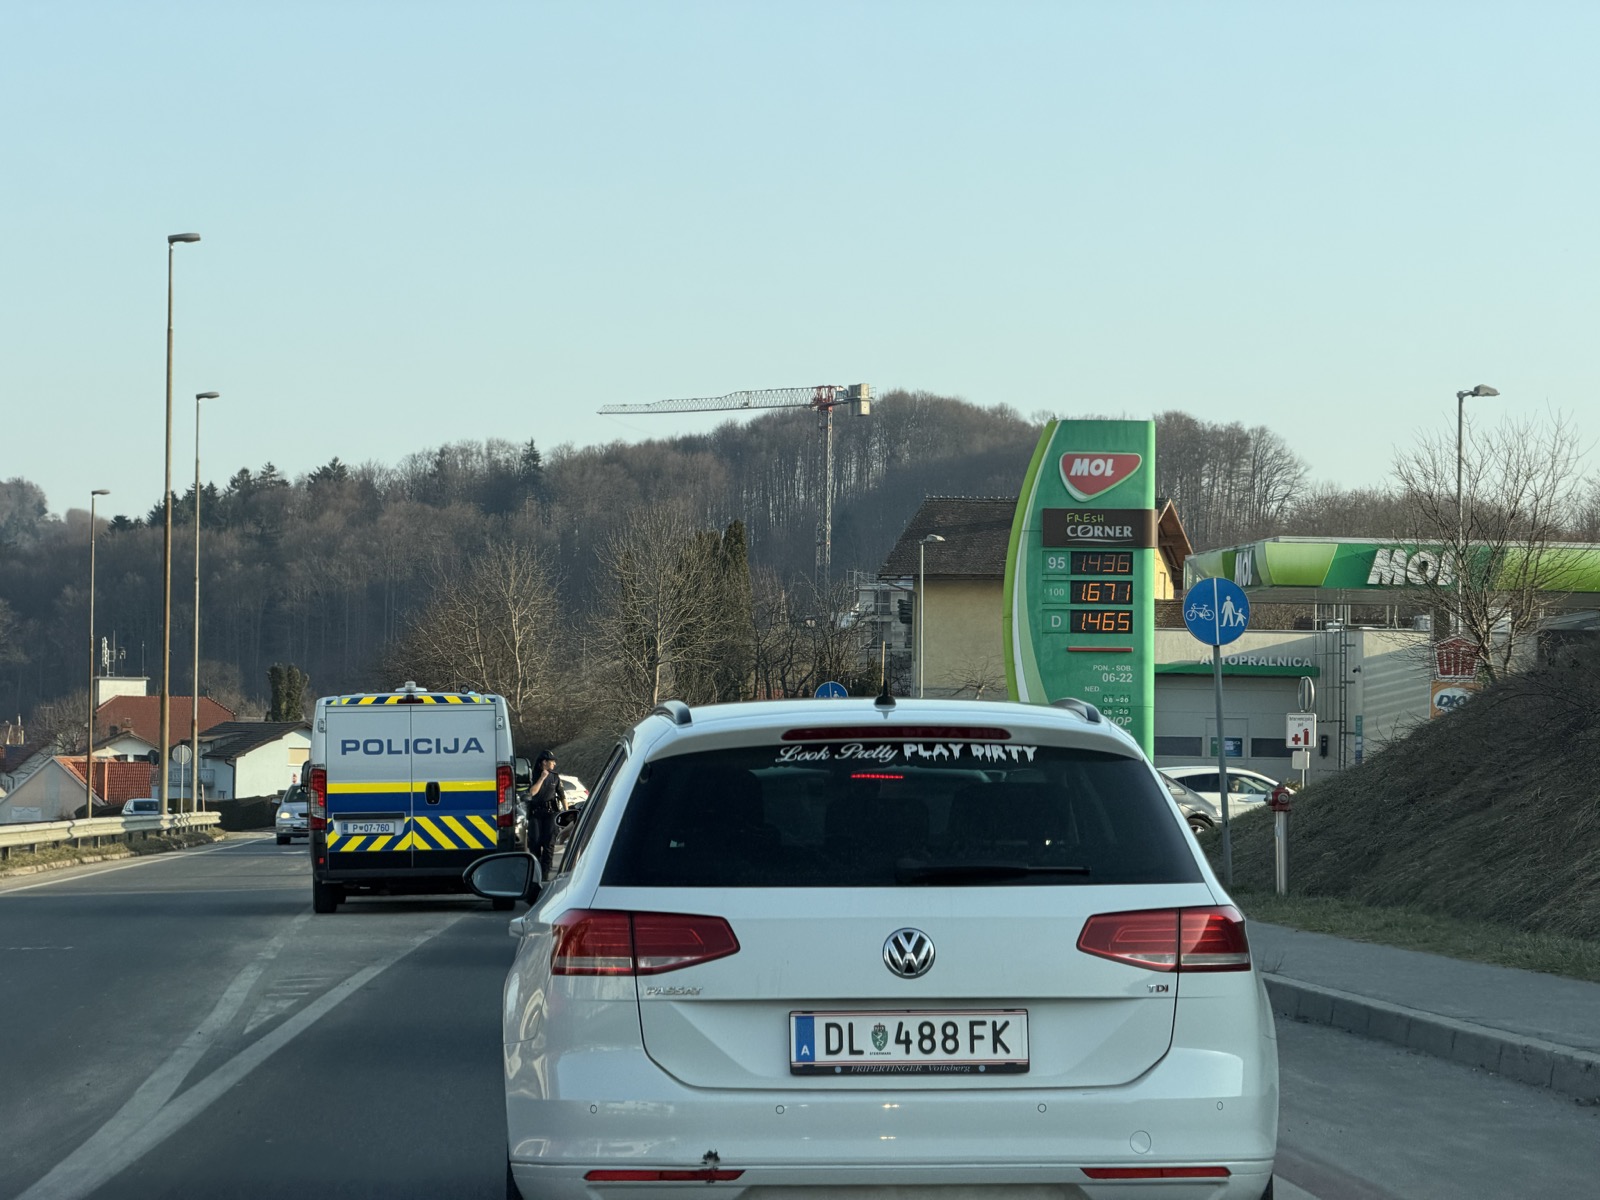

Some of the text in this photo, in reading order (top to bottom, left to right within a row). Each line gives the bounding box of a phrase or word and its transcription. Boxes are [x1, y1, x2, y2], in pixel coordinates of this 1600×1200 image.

[1070, 458, 1114, 477] MOL
[1067, 512, 1104, 523] FRESH
[1067, 525, 1133, 538] CORNER
[1048, 557, 1066, 569] 95
[1235, 550, 1253, 586] MOL
[1049, 588, 1065, 597] 100
[1051, 615, 1062, 627] D
[1102, 673, 1133, 683] 06-22
[341, 737, 485, 756] POLICIJA
[775, 743, 1038, 763] Look Pretty PLAY DIRTY
[646, 986, 703, 995] PASSAT
[1147, 984, 1169, 993] TDI
[824, 1021, 865, 1056] DL
[800, 1044, 810, 1056] A
